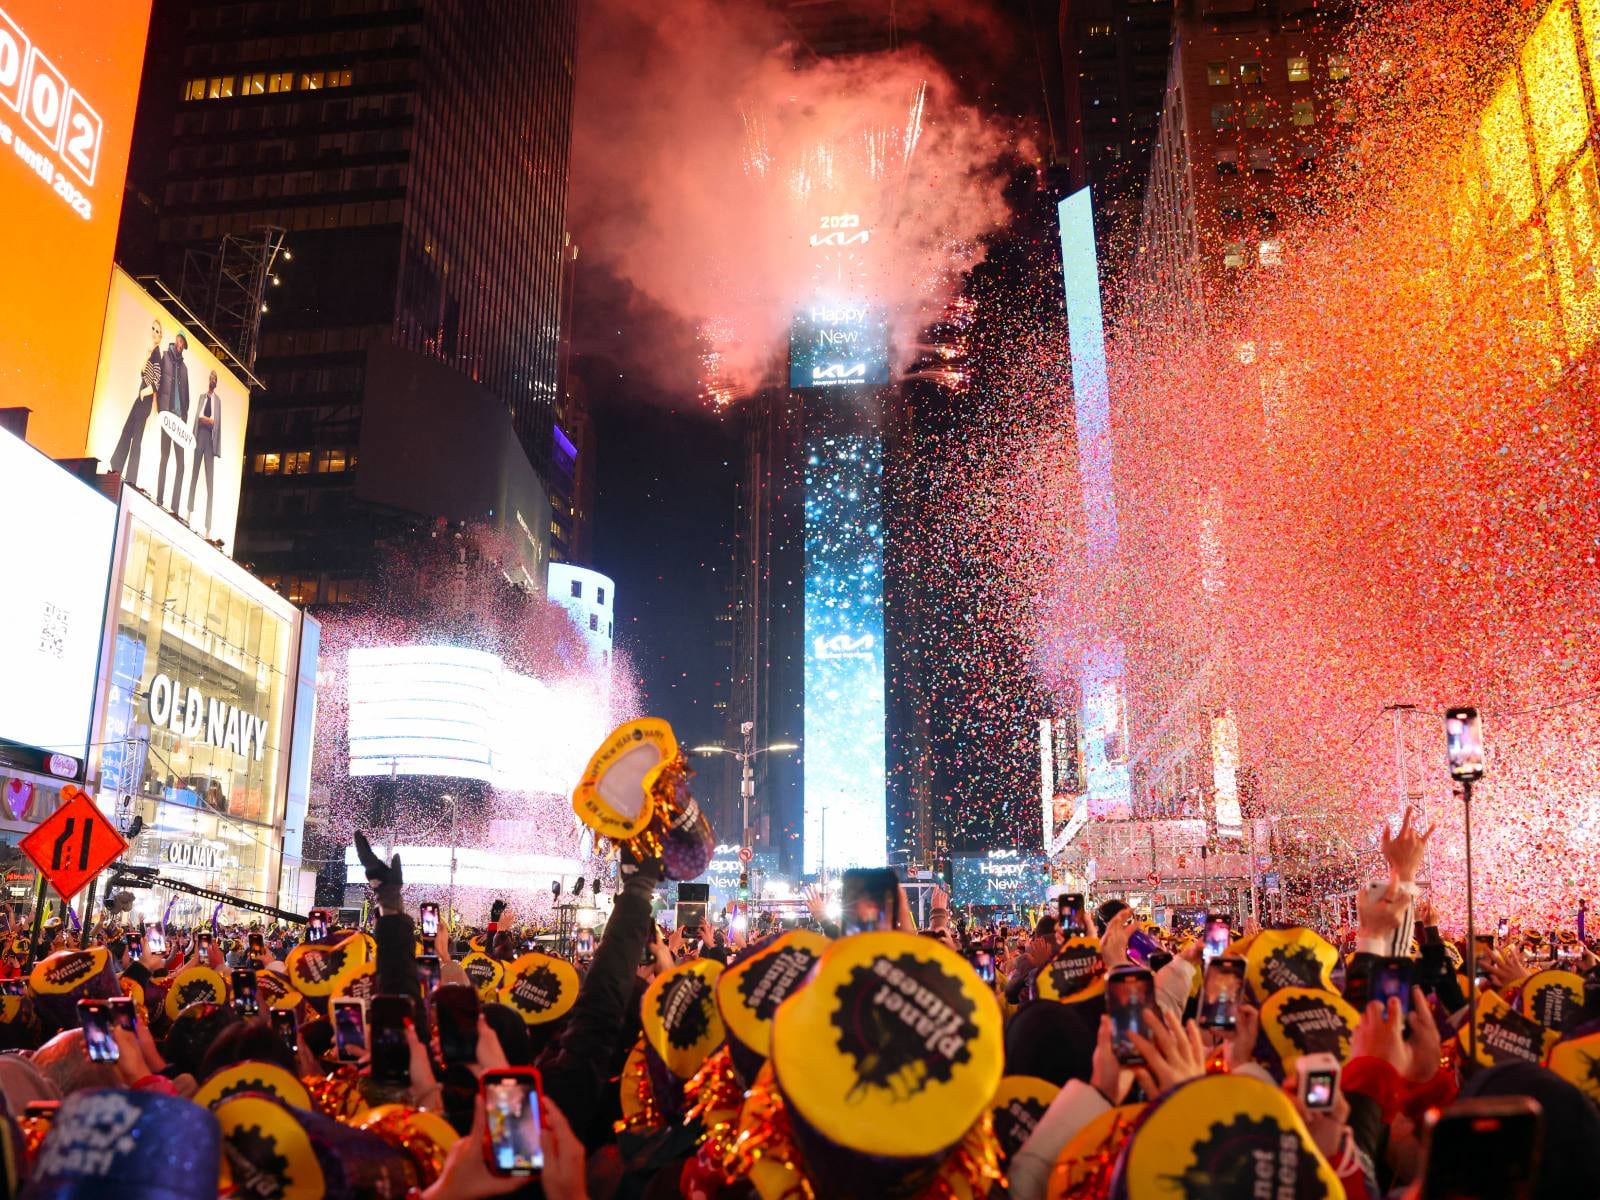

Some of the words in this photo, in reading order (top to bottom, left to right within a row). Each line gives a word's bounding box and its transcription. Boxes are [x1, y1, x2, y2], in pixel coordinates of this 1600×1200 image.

[14, 136, 54, 184] until
[820, 214, 860, 229] 2023
[812, 306, 866, 326] Happy
[820, 329, 859, 345] New
[163, 415, 177, 432] OLD
[176, 425, 193, 447] NAVY
[148, 673, 204, 738] OLD
[204, 696, 269, 762] NAVY
[167, 841, 192, 866] OLD
[190, 843, 219, 868] NAVY
[707, 876, 741, 888] New
[979, 861, 1030, 878] Happy
[988, 878, 1019, 890] New
[515, 979, 549, 998] planet
[747, 957, 793, 1008] fitness
[767, 951, 810, 1004] planet
[515, 986, 552, 1008] fitness
[664, 978, 693, 1030] fitness
[873, 958, 964, 1035] fitness
[1551, 987, 1566, 1021] planet
[873, 984, 965, 1060] planet
[1281, 1008, 1332, 1025] fitness
[1297, 1014, 1343, 1033] planet
[1483, 1023, 1533, 1049] planet
[1486, 1032, 1538, 1063] fitness
